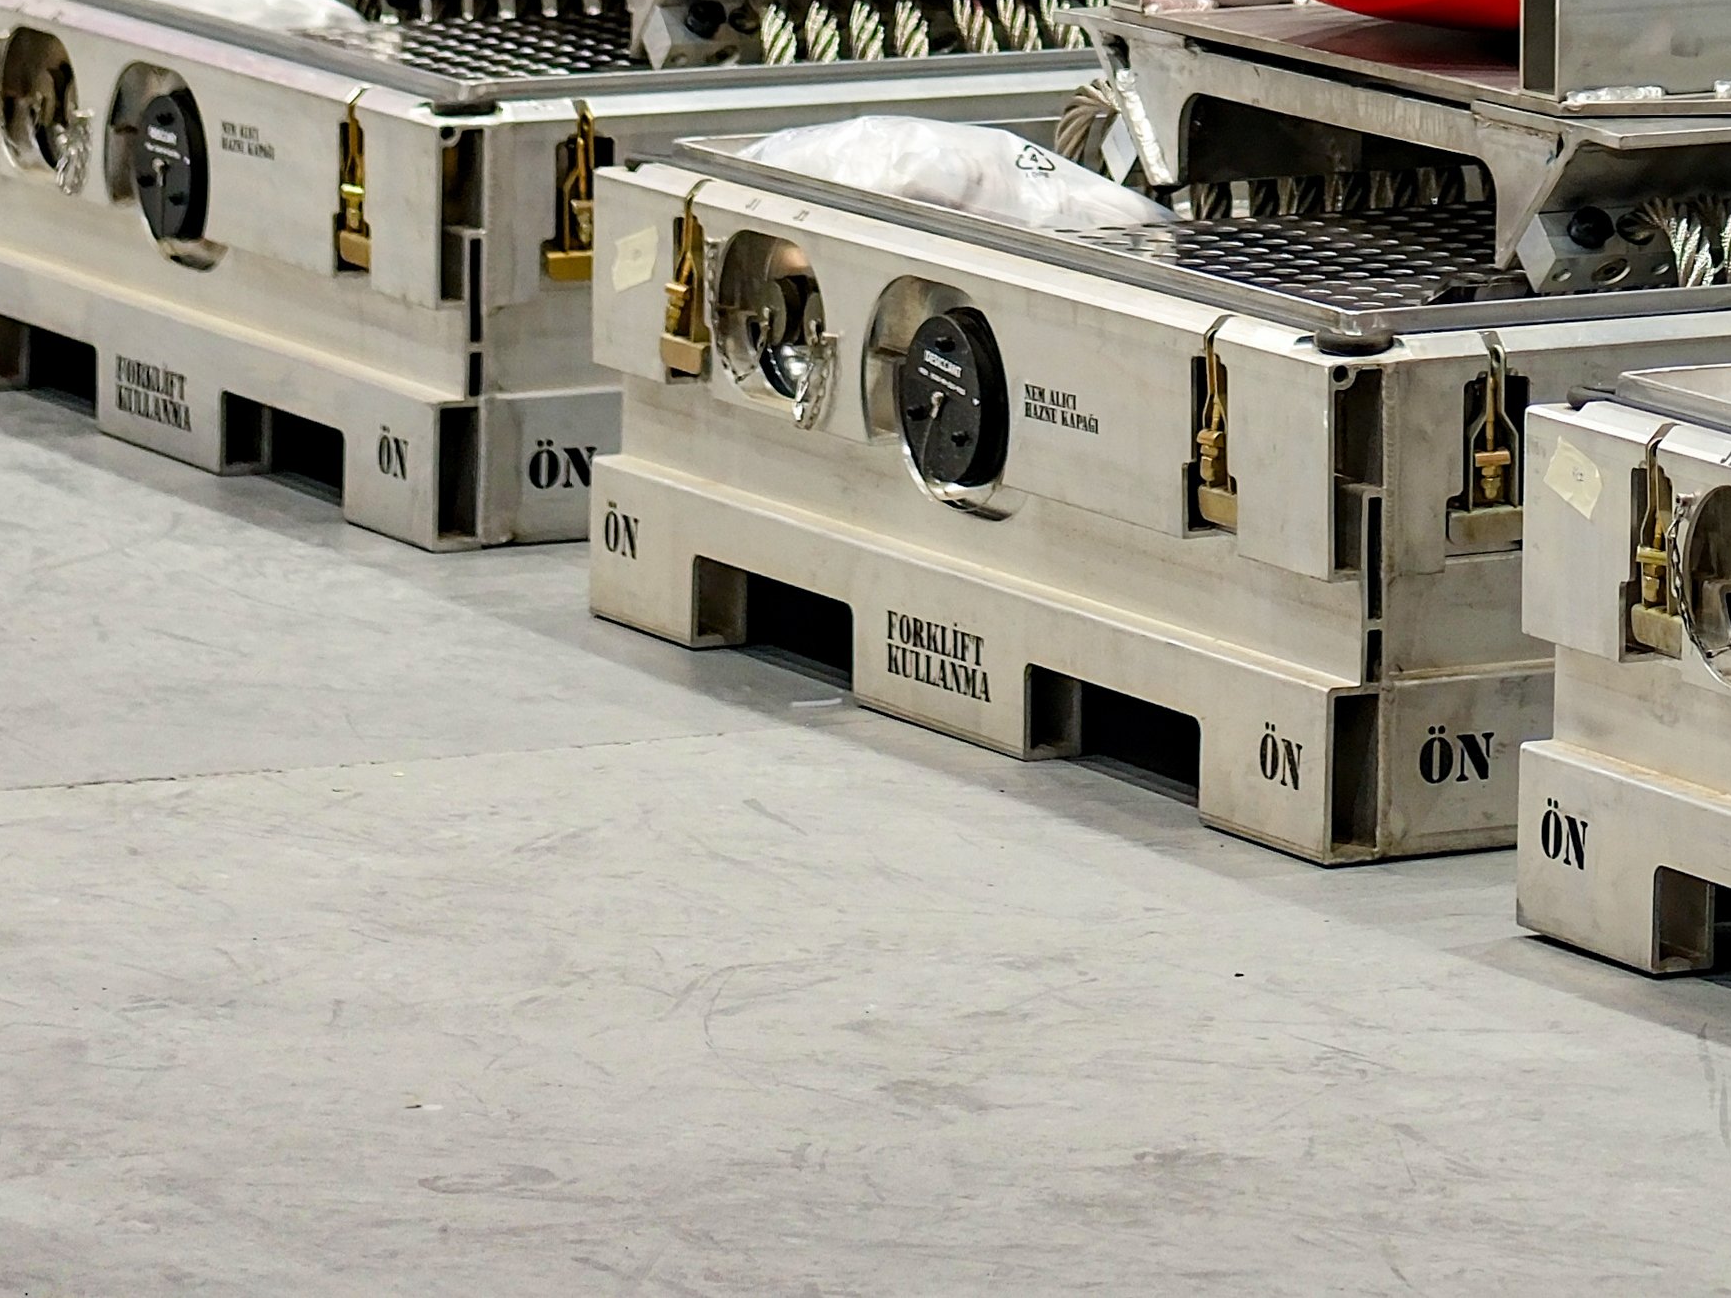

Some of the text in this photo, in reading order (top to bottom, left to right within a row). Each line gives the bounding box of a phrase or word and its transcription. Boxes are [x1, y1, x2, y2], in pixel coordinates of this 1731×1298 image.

[1024, 384, 1076, 410] NEM ALICI
[1024, 402, 1057, 424] HAZNE
[378, 425, 408, 480] ÖN
[604, 501, 639, 560] ÖN
[886, 610, 984, 666] FORKLİFT
[886, 643, 992, 704] KULLANMA
[1260, 722, 1303, 790] ÖN
[1420, 725, 1495, 785] ÖN
[1541, 798, 1589, 870] ÖN
